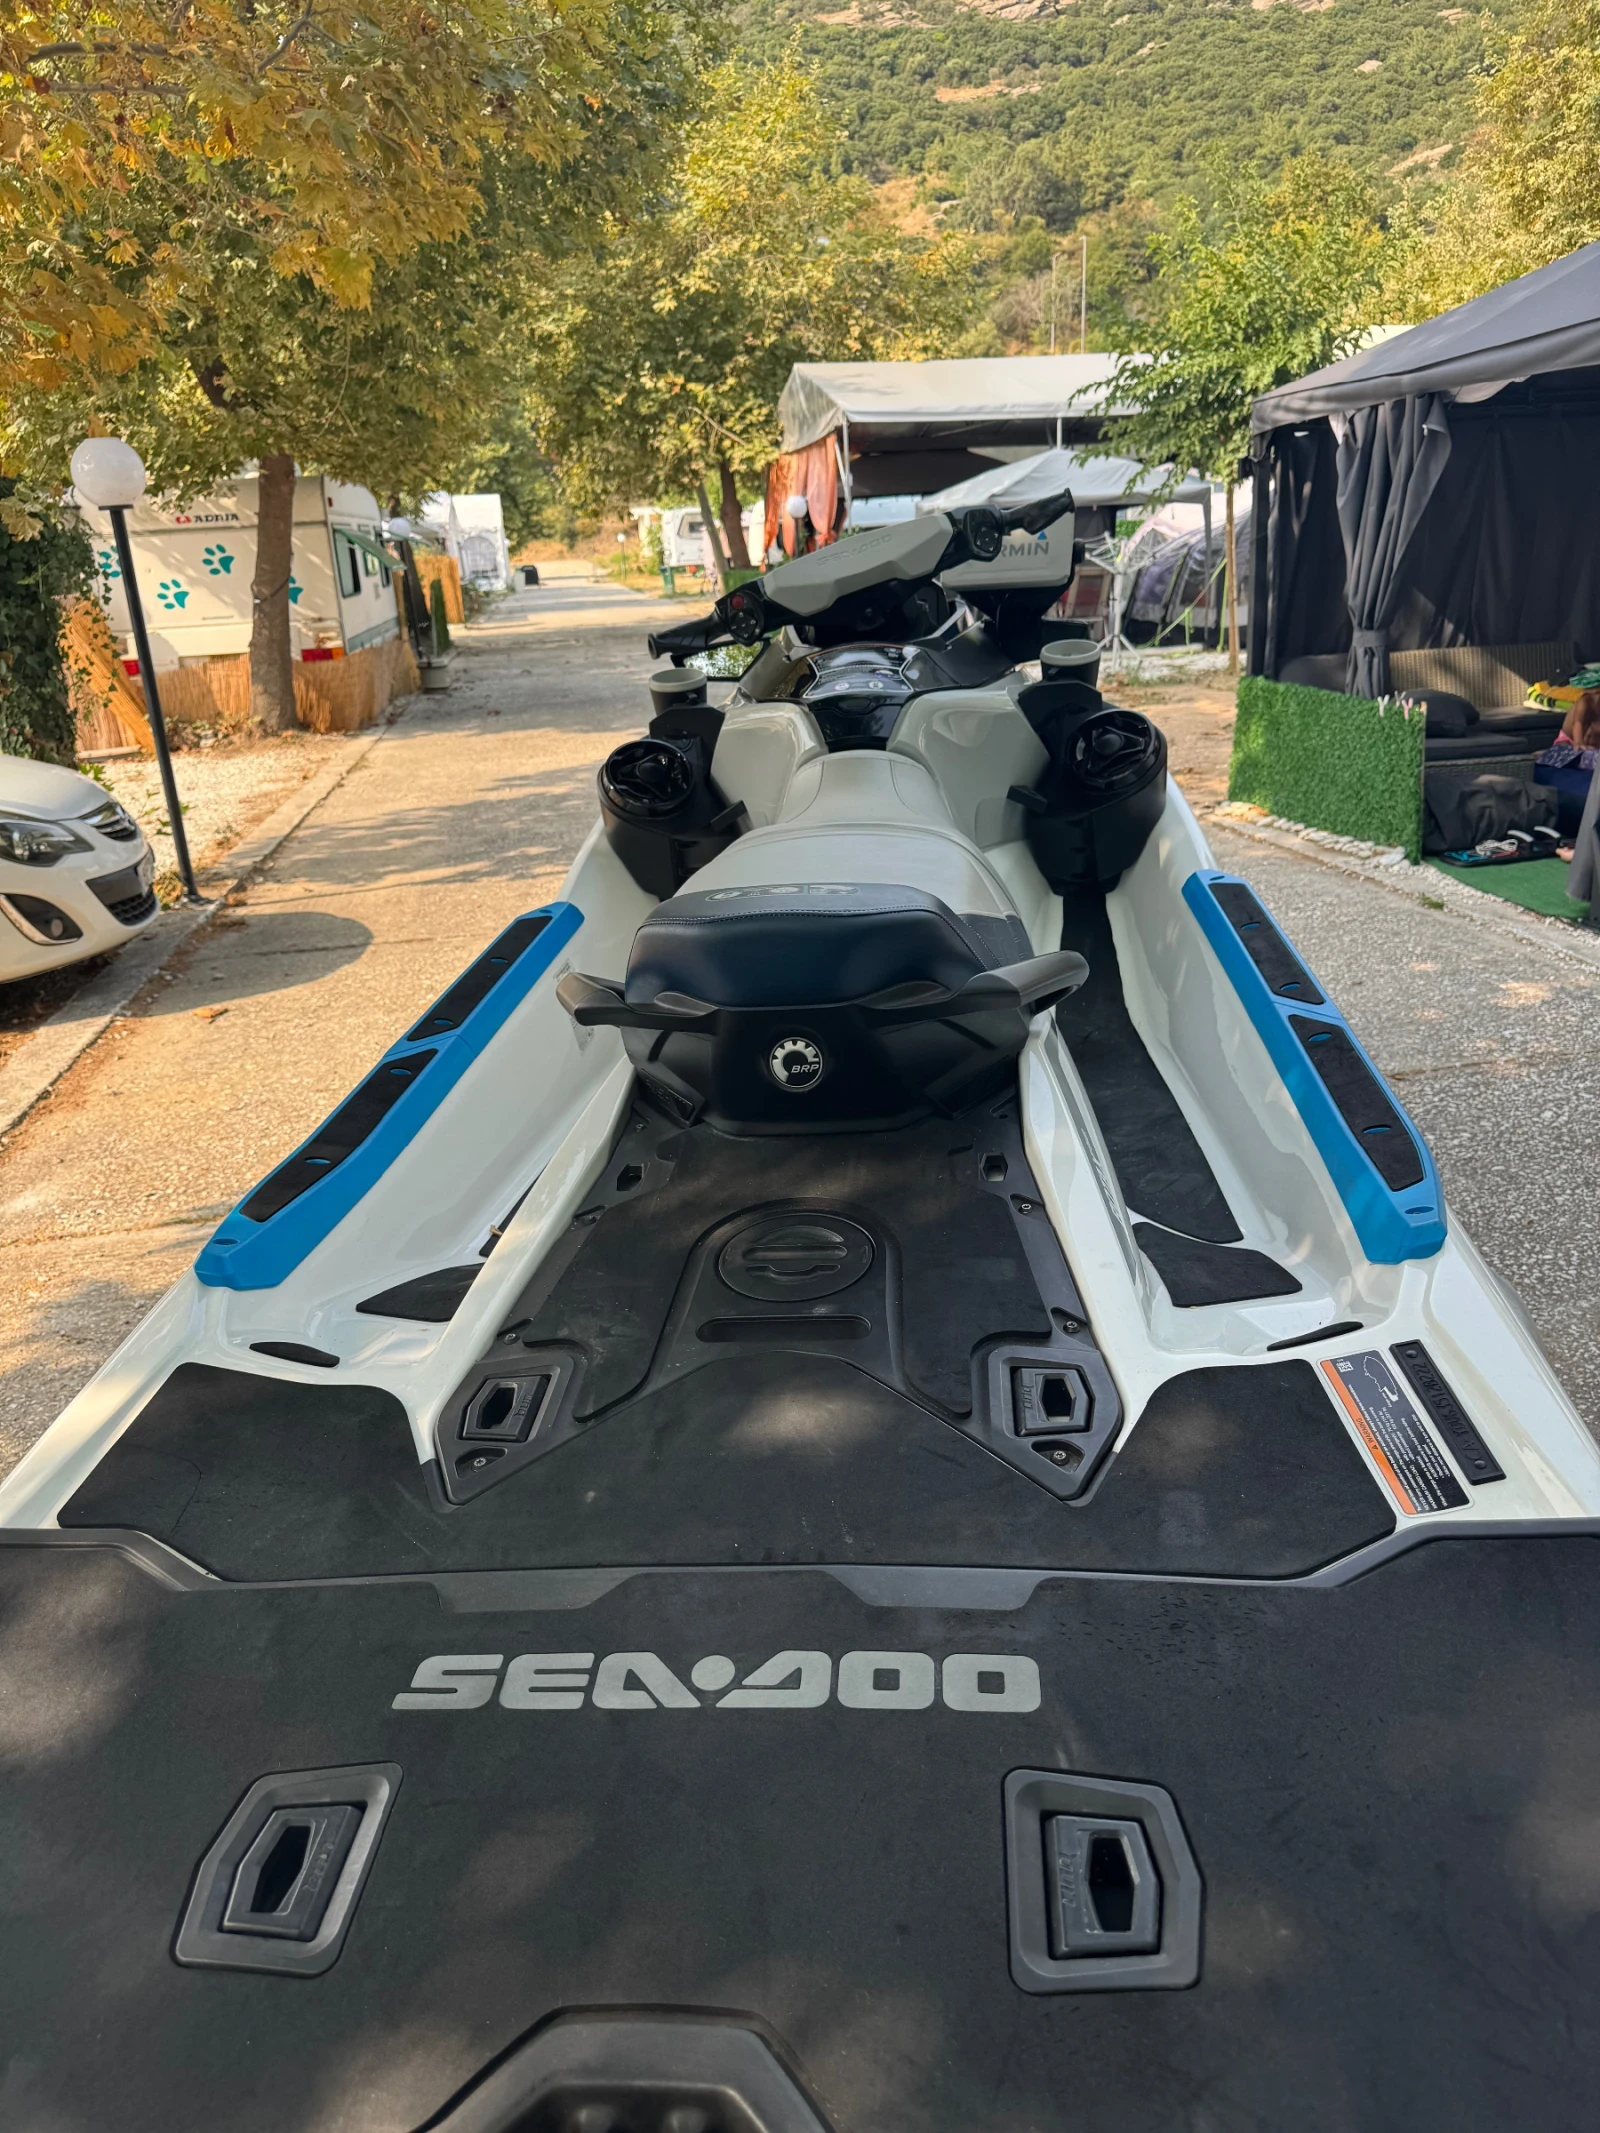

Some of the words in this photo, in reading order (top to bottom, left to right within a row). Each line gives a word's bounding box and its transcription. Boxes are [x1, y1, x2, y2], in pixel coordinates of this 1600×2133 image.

[194, 513, 239, 523] ADRIA
[791, 1063, 819, 1074] BRP
[1356, 1417, 1374, 1443] WARNING
